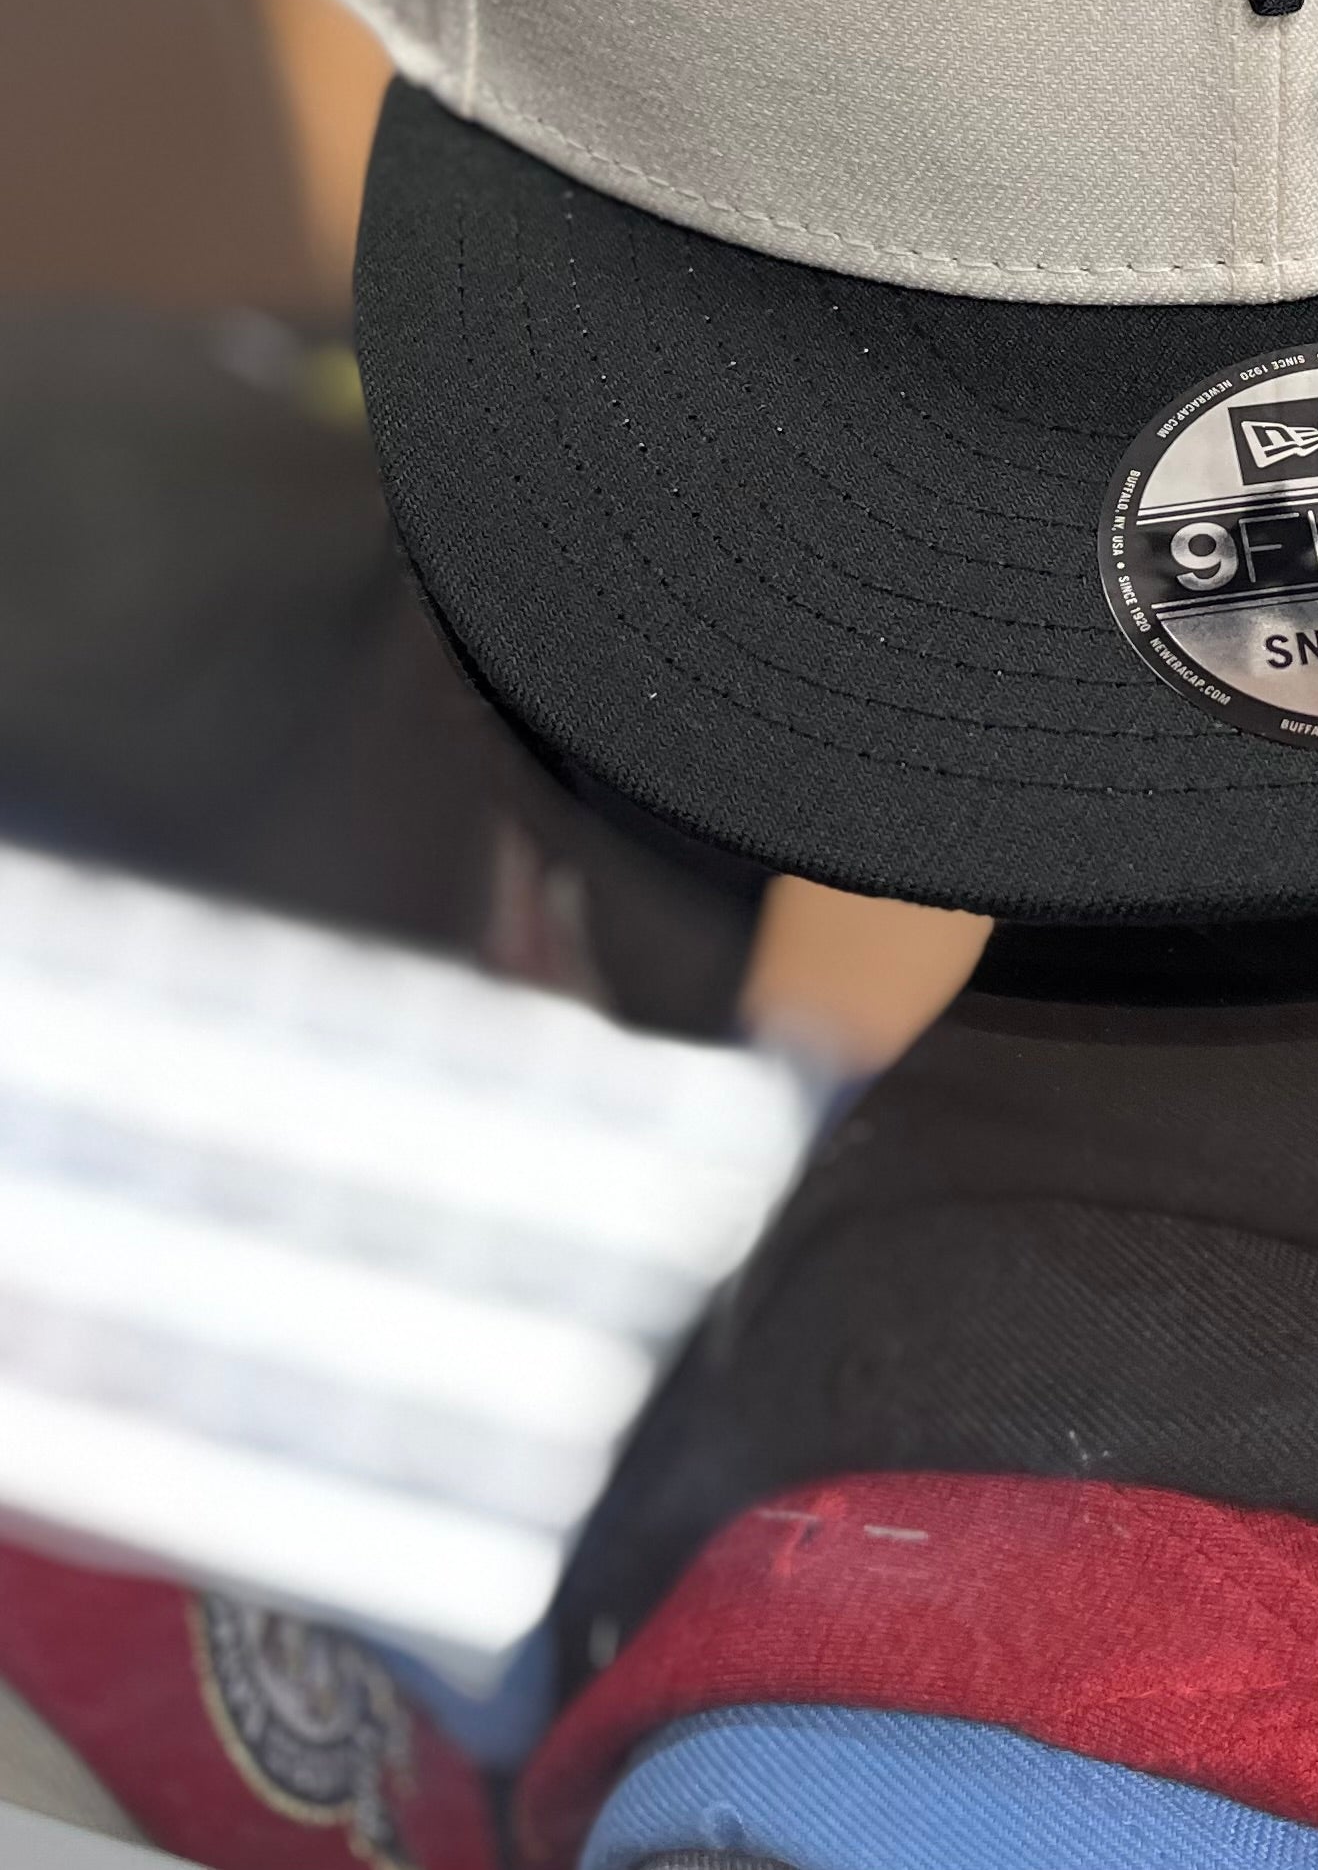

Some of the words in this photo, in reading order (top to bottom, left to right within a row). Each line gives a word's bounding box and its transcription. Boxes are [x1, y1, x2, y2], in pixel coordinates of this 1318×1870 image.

[1240, 364, 1268, 381] 1920
[1271, 355, 1305, 370] SINCE
[1156, 379, 1233, 439] NEWERACAP.COM
[1112, 535, 1124, 556] USA
[1118, 575, 1138, 606] SINCE
[1130, 607, 1151, 633] 1920
[1150, 637, 1231, 706] NEWERACAP.COM
